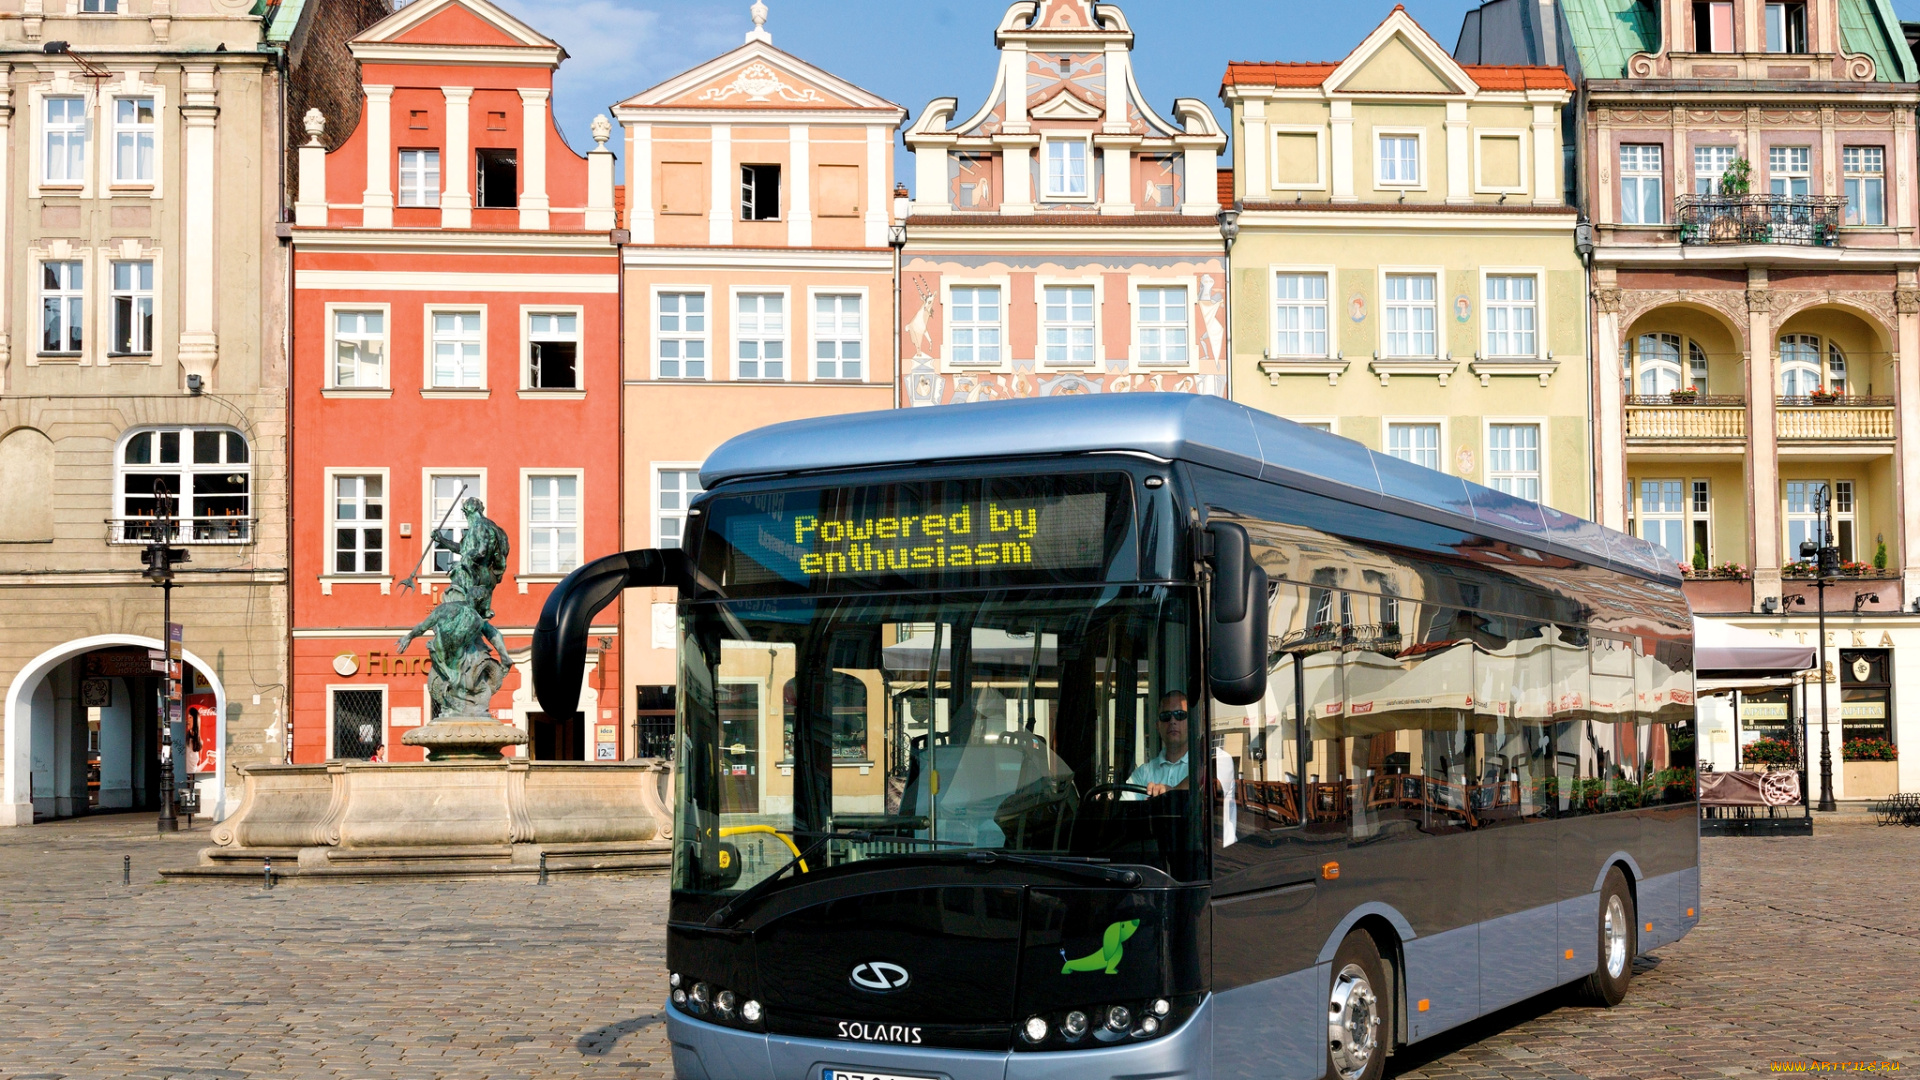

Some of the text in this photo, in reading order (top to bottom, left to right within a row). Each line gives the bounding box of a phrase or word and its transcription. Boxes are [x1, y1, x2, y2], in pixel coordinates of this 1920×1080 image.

[795, 504, 970, 543] Powered
[989, 503, 1037, 538] by
[800, 538, 1031, 574] enthusiasm
[1743, 707, 1785, 716] APTEKA
[1841, 706, 1883, 715] APTEKA
[837, 1021, 922, 1044] SOLARIS
